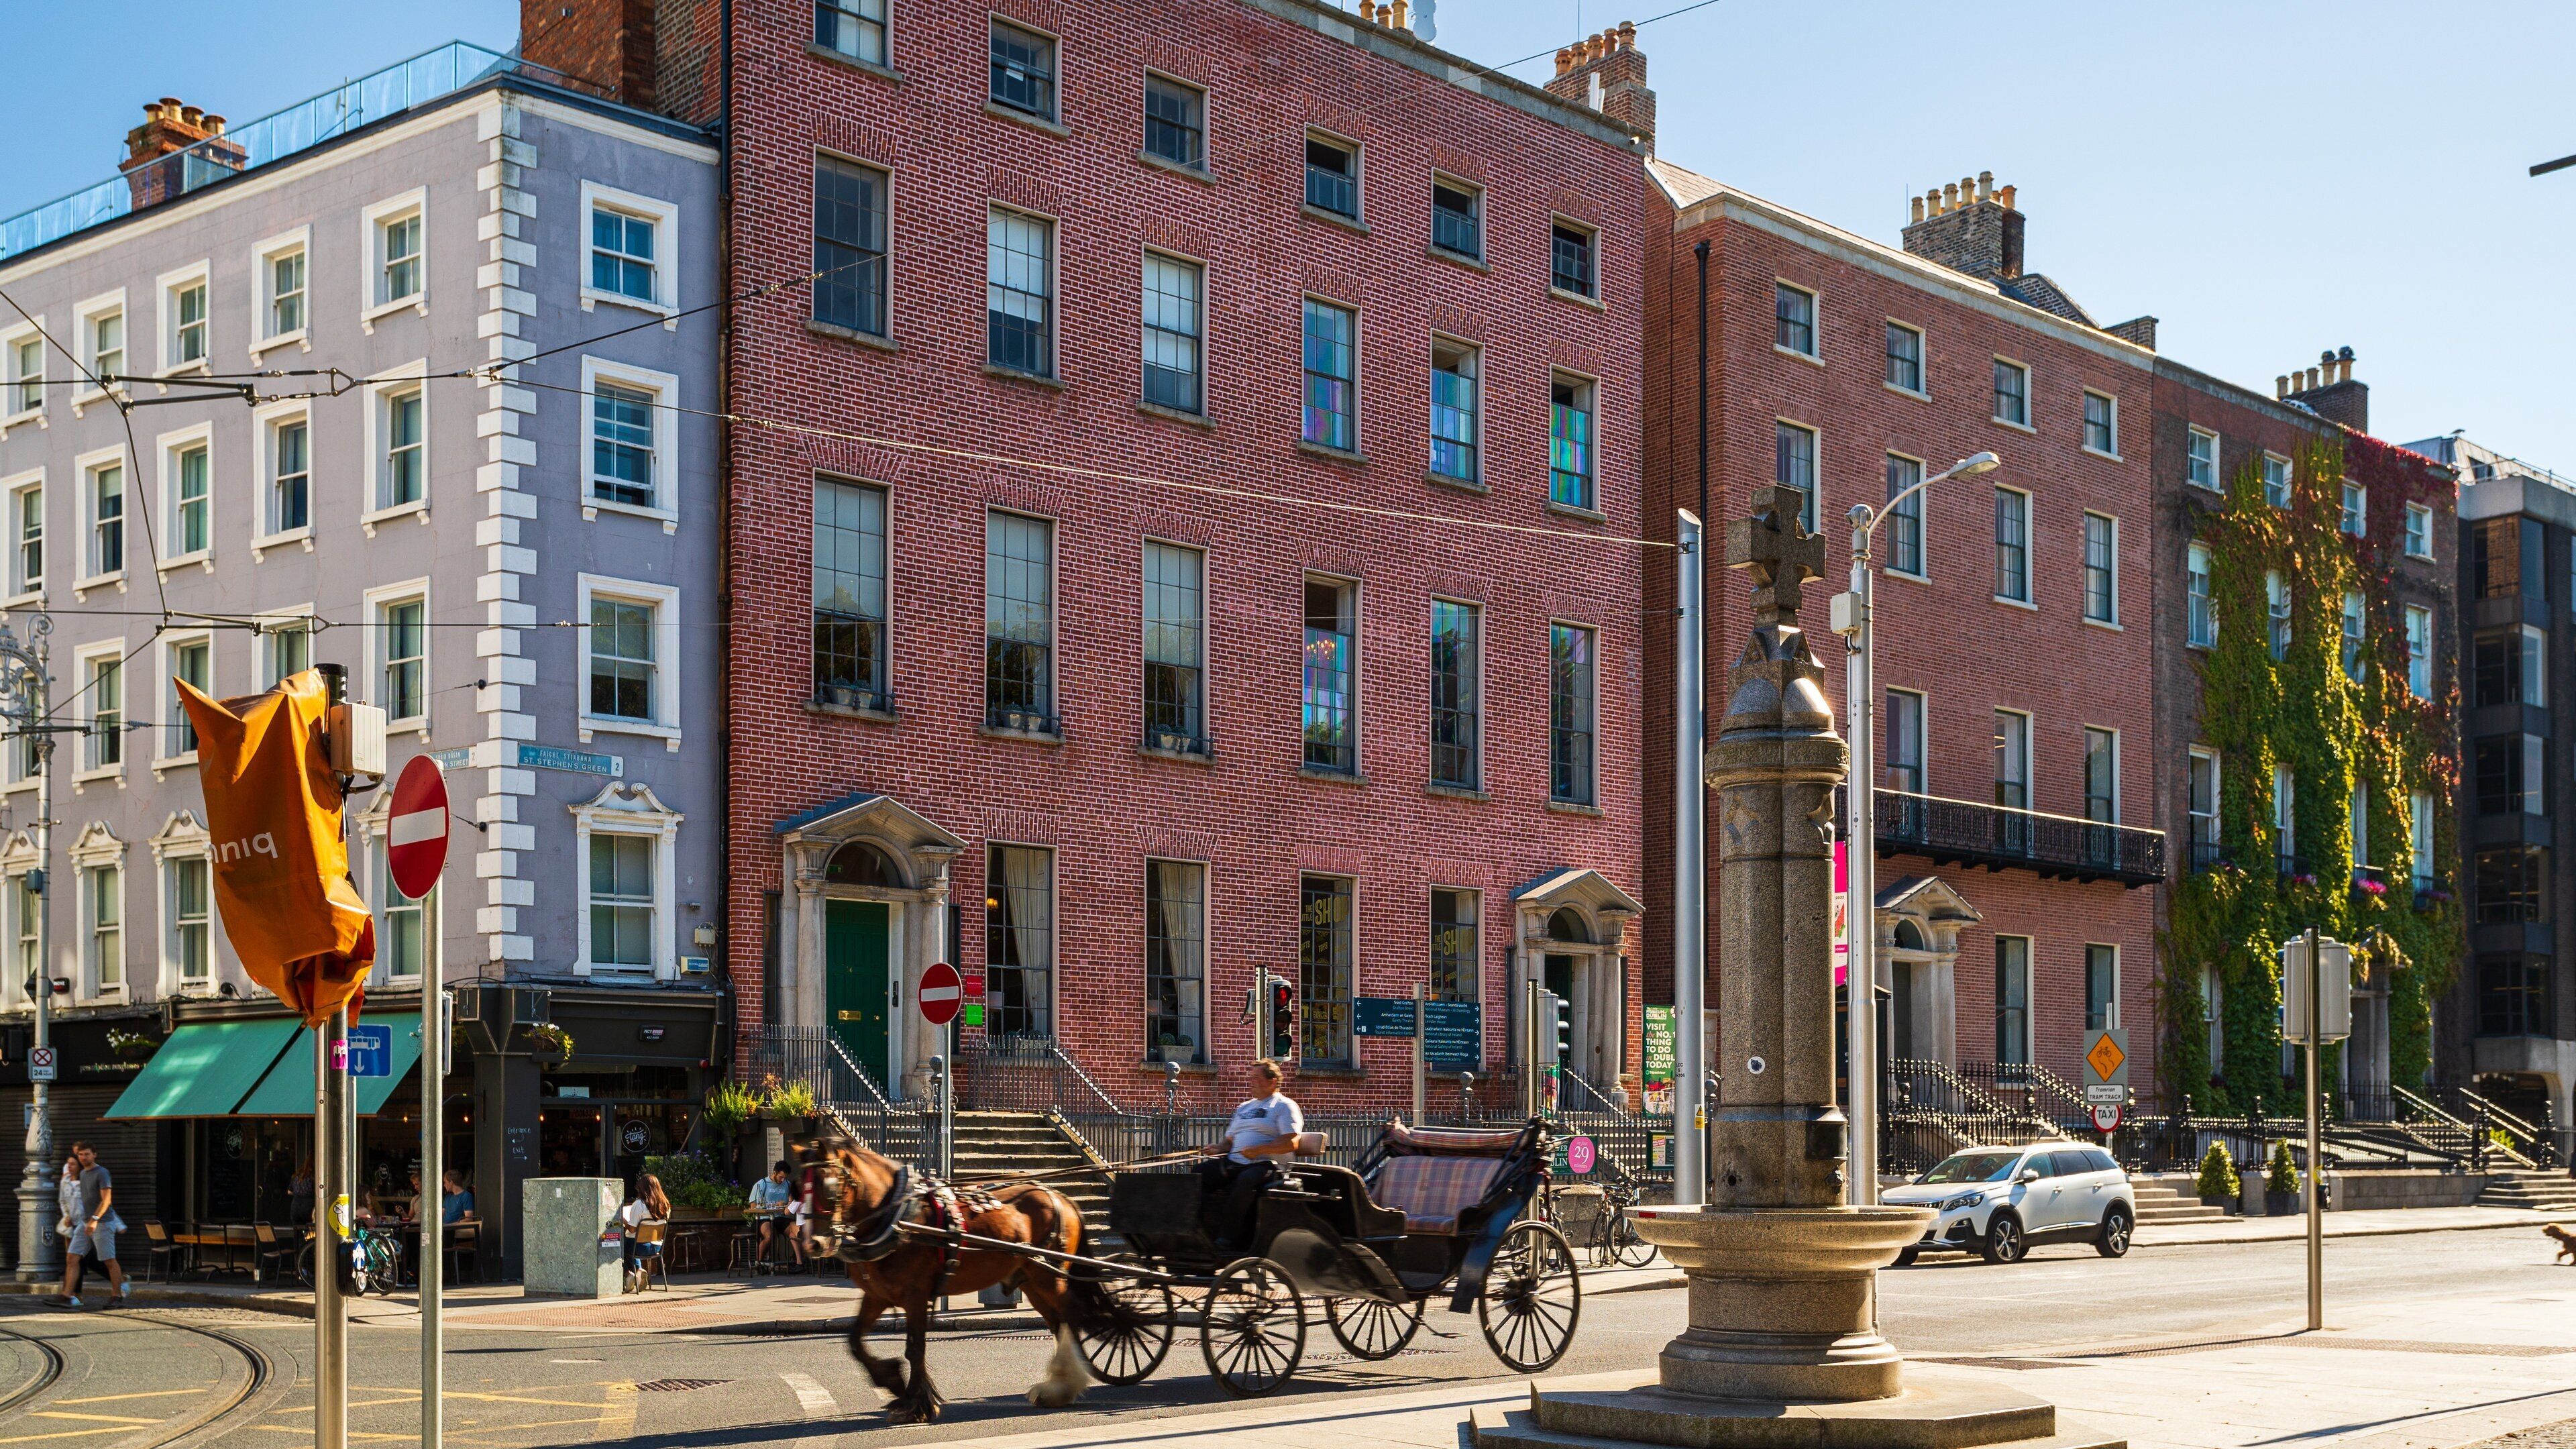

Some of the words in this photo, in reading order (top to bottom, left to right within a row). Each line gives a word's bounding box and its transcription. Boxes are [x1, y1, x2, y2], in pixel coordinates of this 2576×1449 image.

[472, 752, 476, 761] 2
[540, 750, 558, 759] FAICHE
[450, 758, 468, 767] STREET
[615, 762, 620, 772] 2
[582, 763, 607, 773] GREEN
[1646, 1022, 1666, 1030] VISIT
[1656, 1030, 1672, 1038] NO.
[1646, 1038, 1672, 1046] THING
[1646, 1045, 1656, 1053] TO
[1658, 1046, 1671, 1054] DO
[1653, 1053, 1676, 1061] DUBL
[1646, 1061, 1672, 1069] TODAY
[2097, 1110, 2116, 1119] TAXI
[513, 1146, 525, 1155] Exit
[1574, 1145, 1589, 1165] 29
